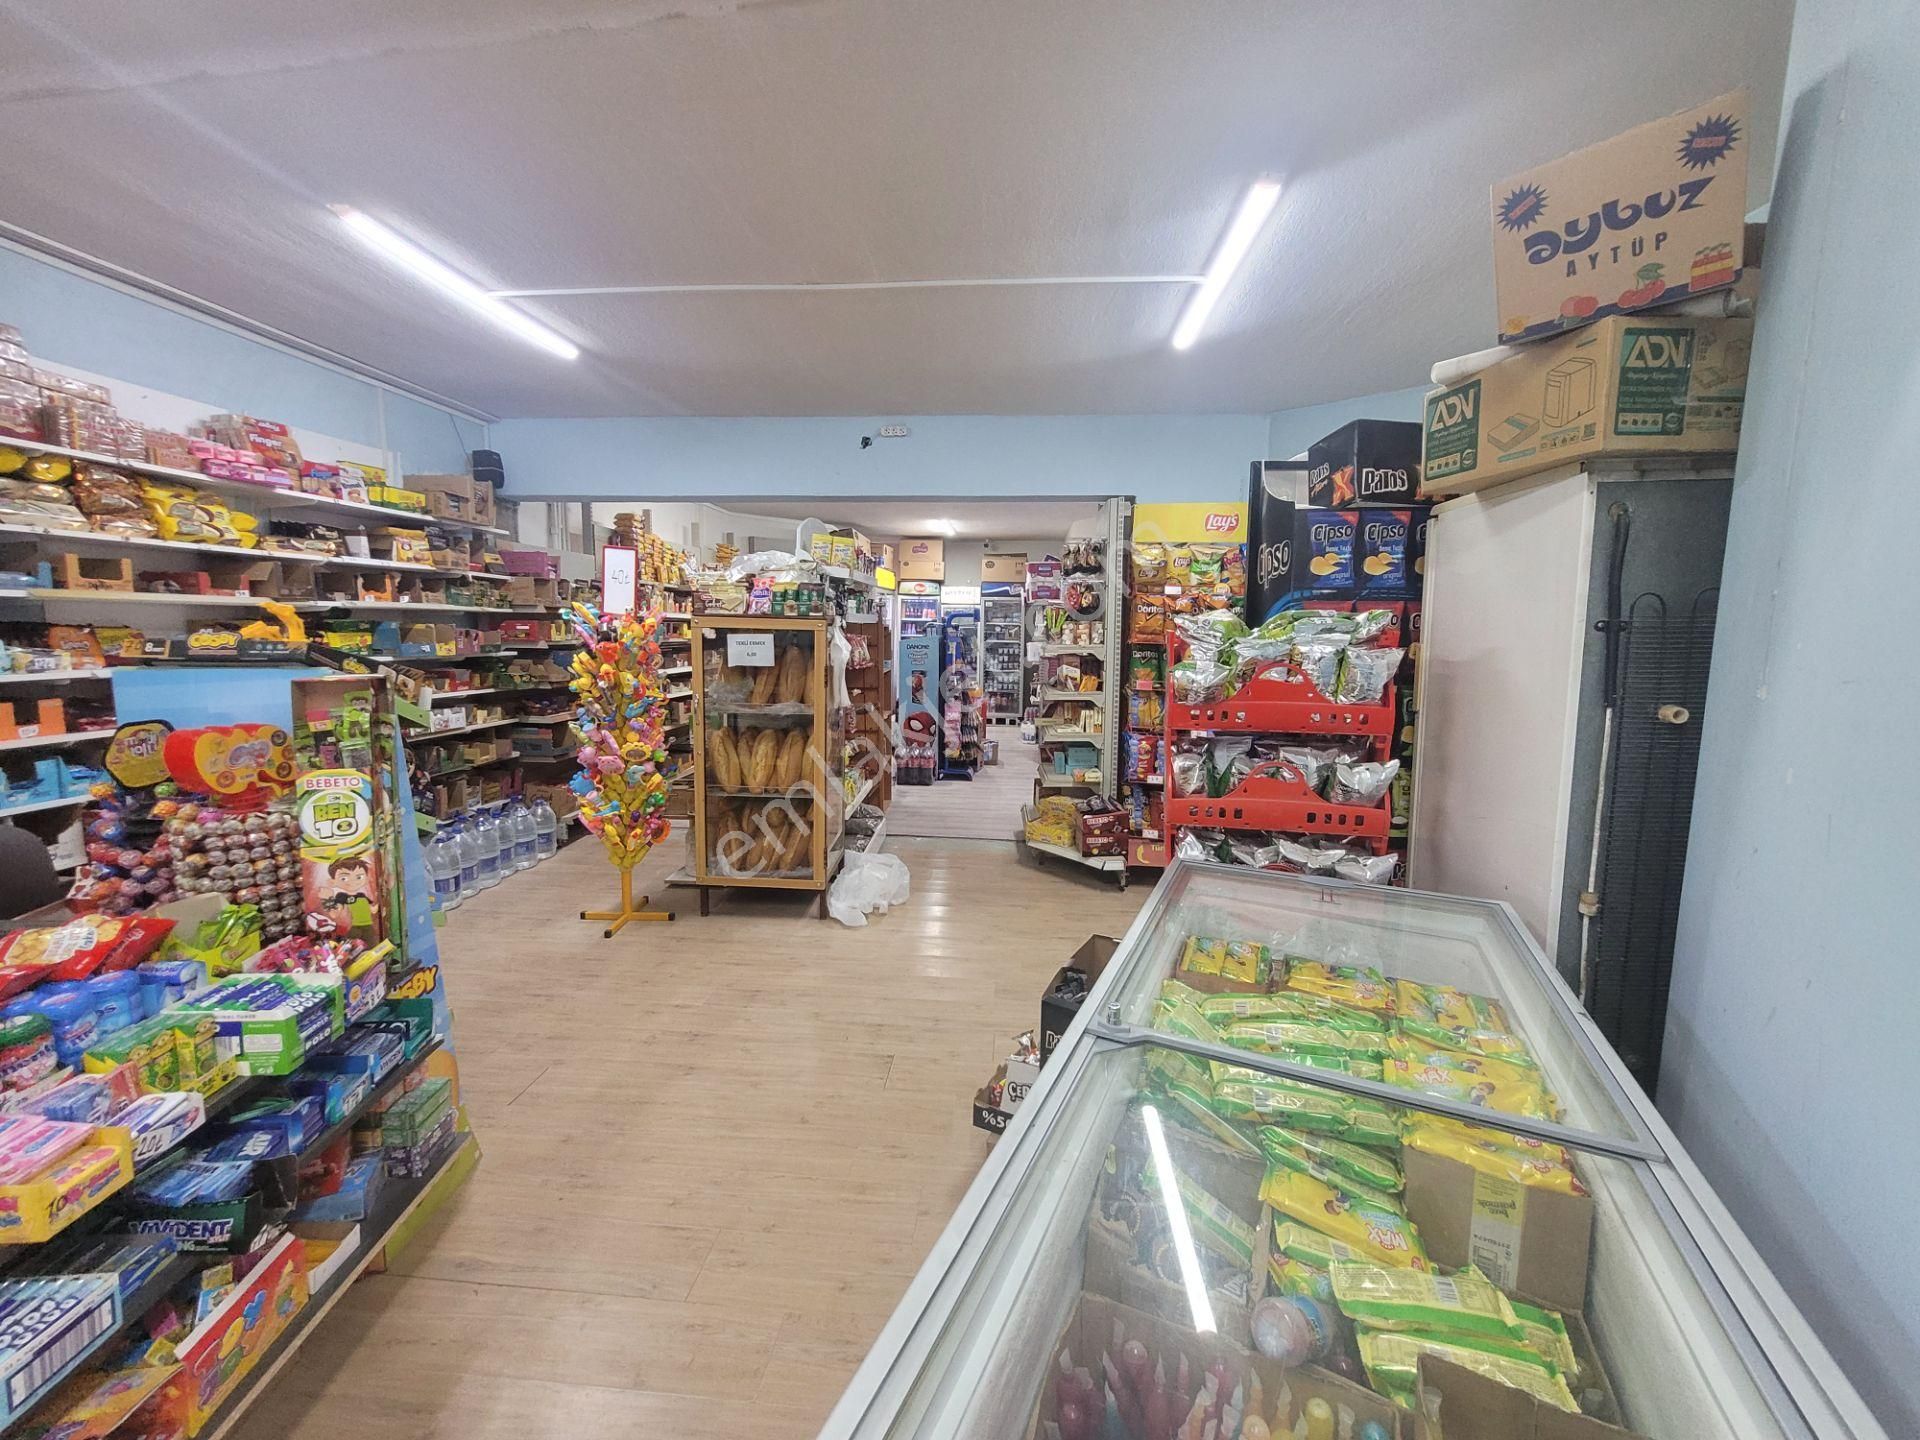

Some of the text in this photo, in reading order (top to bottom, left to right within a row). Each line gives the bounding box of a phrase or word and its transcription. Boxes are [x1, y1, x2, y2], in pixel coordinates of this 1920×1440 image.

[1523, 175, 1716, 265] aybuz
[1566, 231, 1668, 278] AYTÜP
[1207, 513, 1239, 531] Lay's
[1311, 524, 1354, 547] Cipso
[1364, 523, 1406, 546] Cipso
[306, 778, 361, 788] BEBETO
[314, 803, 356, 821] BEN
[314, 819, 358, 839] 10
[306, 1028, 331, 1051] POLO
